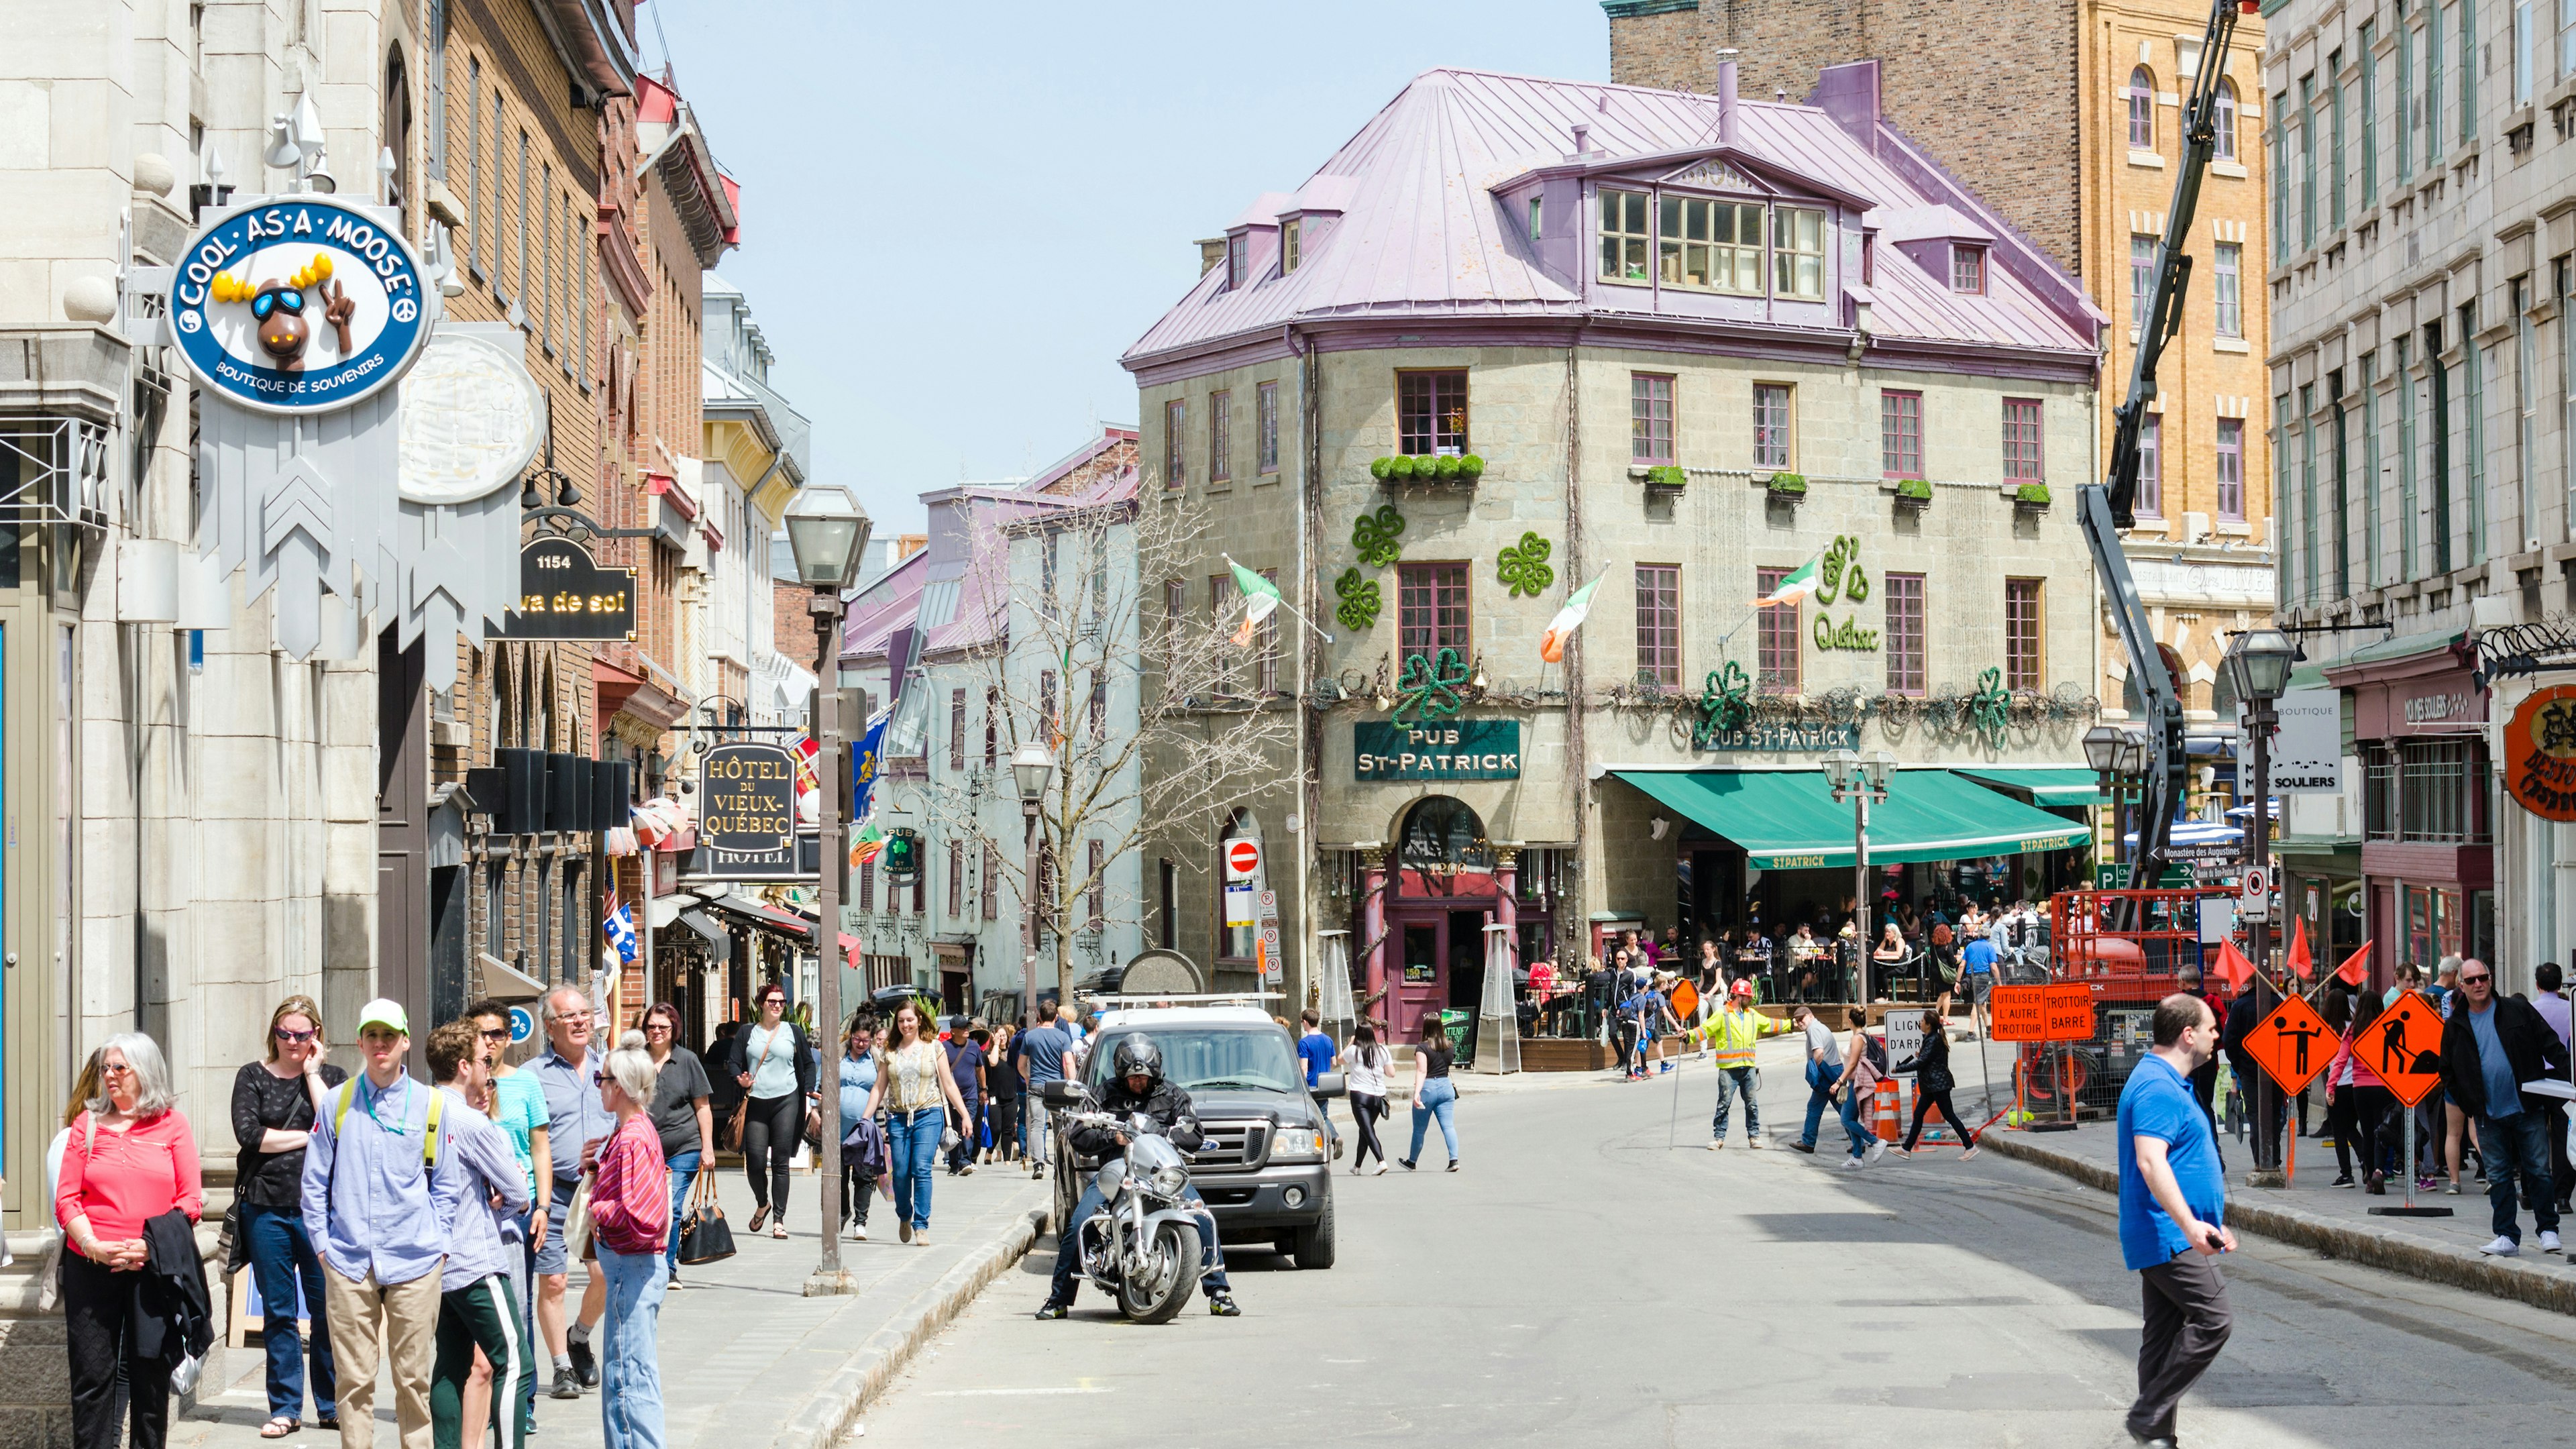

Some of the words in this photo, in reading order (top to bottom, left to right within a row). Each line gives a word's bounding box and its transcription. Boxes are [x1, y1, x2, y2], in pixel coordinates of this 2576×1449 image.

[179, 235, 237, 305] COOL
[247, 209, 285, 242] AS
[292, 209, 313, 233] A
[326, 215, 411, 294] MOOSE
[215, 361, 285, 394] BOUTIQUE
[287, 381, 306, 394] DE
[311, 353, 384, 393] SOUVENIRS
[537, 555, 571, 569] 1154
[552, 590, 583, 612] de
[589, 590, 625, 612] soi
[2279, 707, 2333, 716] BOUTIQUE
[2404, 698, 2414, 722] MOI
[2414, 698, 2424, 720] MES
[2424, 694, 2447, 720] SOULIERS
[1409, 729, 1460, 745] PUB
[1708, 730, 1743, 747] PUB
[708, 755, 789, 780] HÔTEL
[740, 782, 755, 792] DU
[2275, 777, 2335, 788] SOULIERS
[714, 794, 784, 812] VIEUX-
[706, 812, 790, 835] QUÉBEC
[888, 828, 913, 837] PUB
[2164, 847, 2195, 858] Monastère
[2196, 847, 2206, 857] des
[2208, 846, 2241, 857] Augustines
[1430, 862, 1467, 876] 1200
[1405, 968, 1420, 976] 150
[1998, 994, 2041, 1004] UTILISER
[2046, 996, 2090, 1009] TROTTOIR
[2000, 1009, 2039, 1019] L'AUTRE
[1895, 1020, 1921, 1031] LIGN
[2051, 1013, 2086, 1029] BARRÉ
[1444, 1026, 1469, 1036] ATTENDEZ
[1998, 1024, 2041, 1034] TROTTOIR
